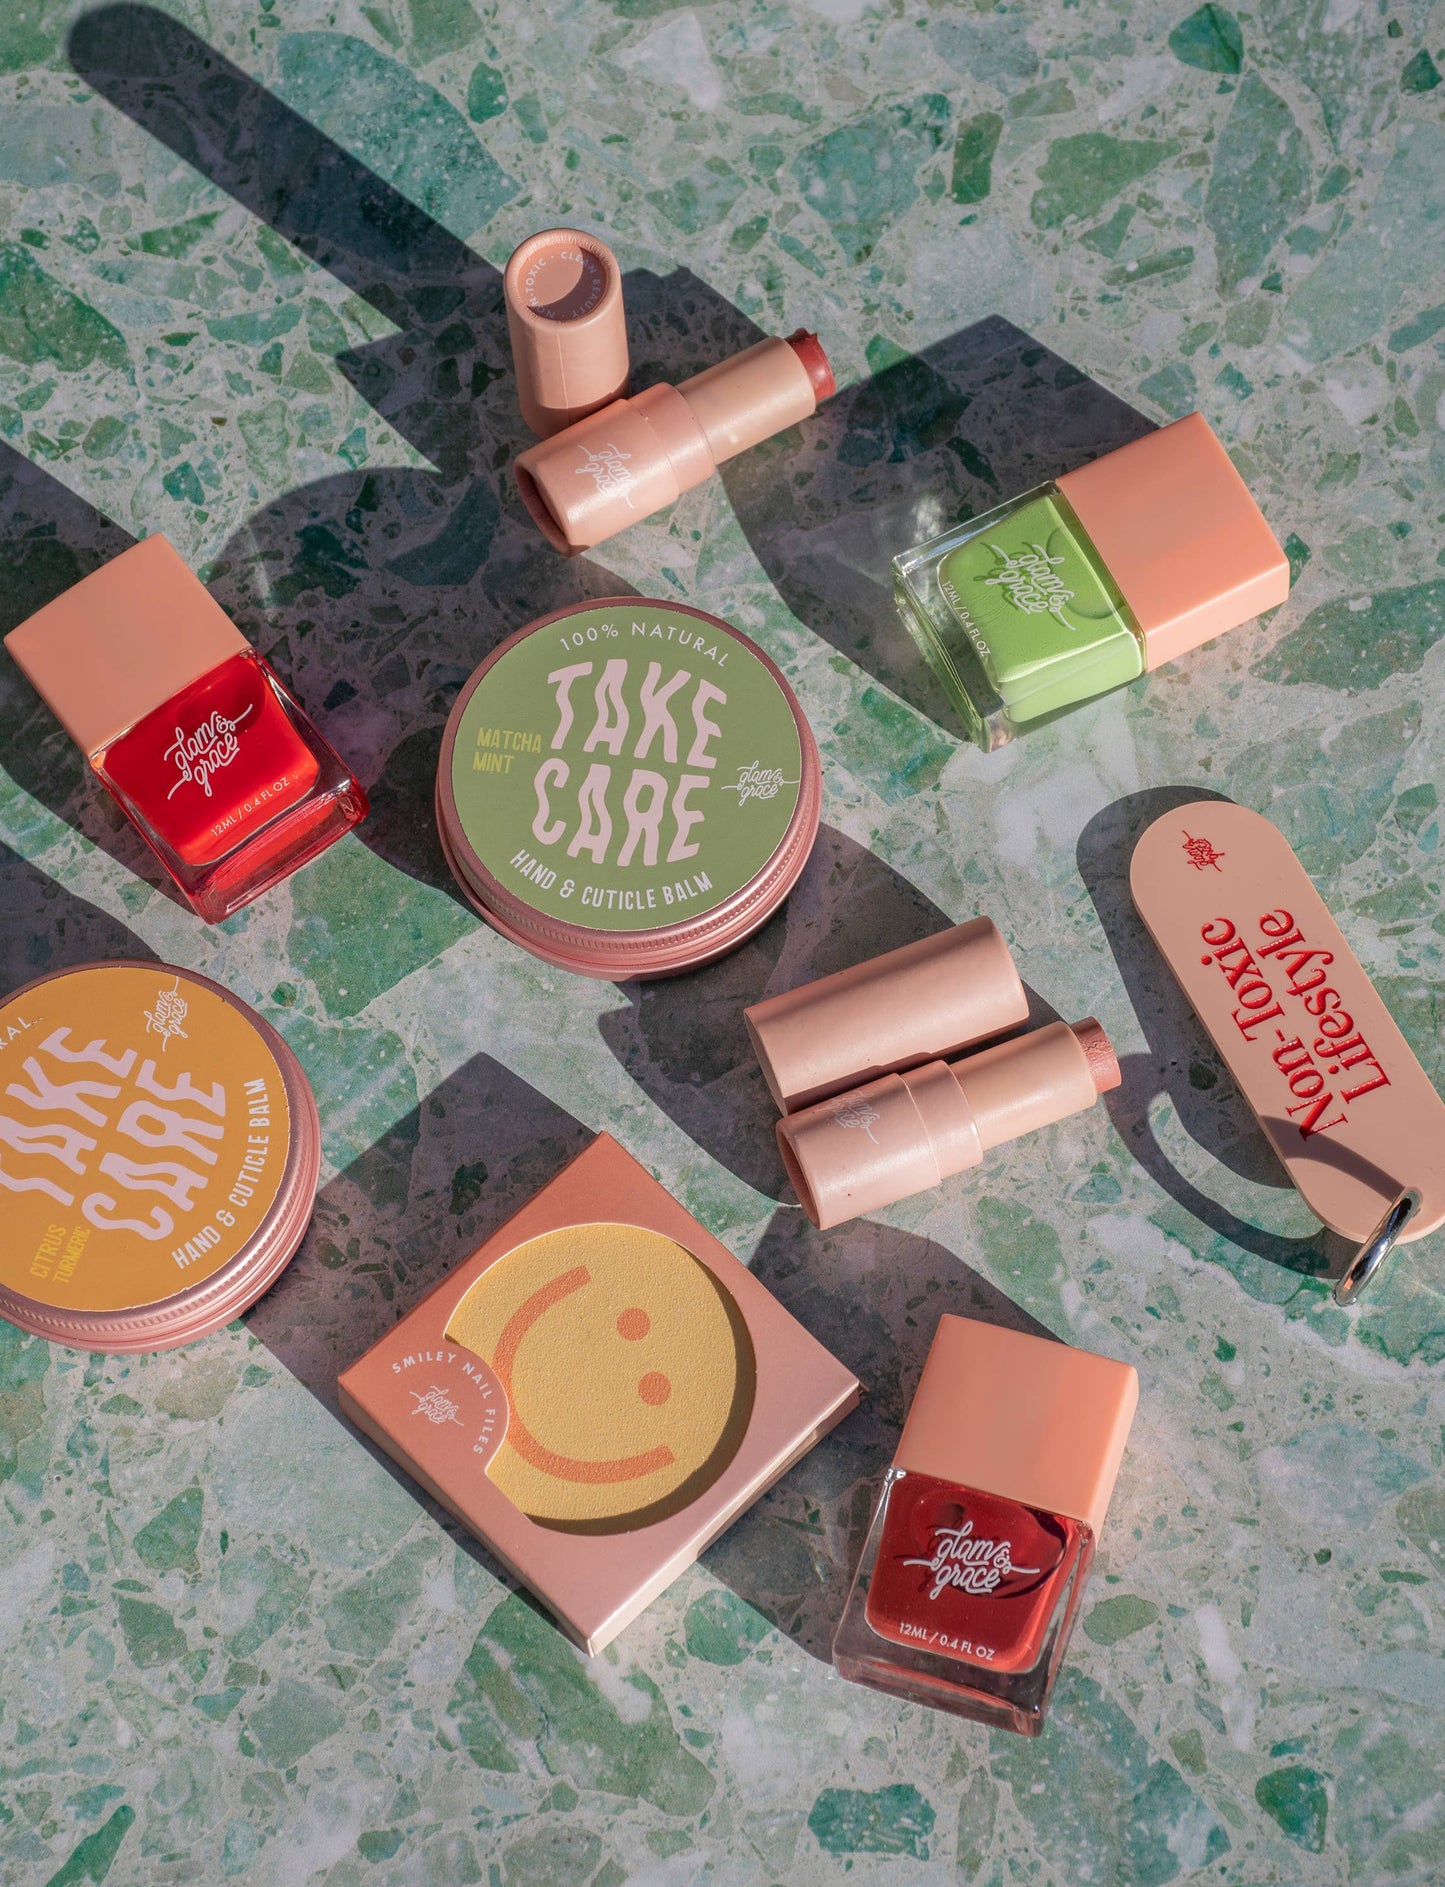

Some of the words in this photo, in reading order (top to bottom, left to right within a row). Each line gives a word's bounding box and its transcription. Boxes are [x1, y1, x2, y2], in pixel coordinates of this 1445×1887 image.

[560, 251, 598, 274] CLEAN
[571, 278, 601, 318] BEAUTY
[985, 569, 1049, 615] grace
[942, 580, 961, 606] 12ML
[960, 611, 976, 629] 0.4
[969, 628, 981, 641] FL
[976, 640, 991, 657] OZ
[559, 623, 619, 652] 100%
[631, 621, 730, 667] NATURAL
[547, 658, 727, 769] TAKE
[472, 751, 516, 775] MINT
[476, 727, 543, 753] MATCHA
[193, 732, 241, 798] grace
[210, 815, 237, 837] 12ML
[243, 797, 261, 812] 0.4
[260, 789, 273, 801] FL
[272, 776, 290, 792] OZ
[532, 758, 711, 868] CARE
[738, 783, 779, 807] grace
[510, 848, 557, 891] HAND
[559, 878, 575, 899] &
[581, 885, 656, 911] CUTICLE
[662, 871, 714, 906] BALM
[168, 998, 189, 1039] grace
[1200, 917, 1349, 1142] Non-Toxic
[1256, 908, 1392, 1105] Lifestyle
[0, 1026, 138, 1207] TAKE
[243, 1077, 270, 1127] BALM
[81, 1059, 227, 1241] CARE
[228, 1134, 270, 1208] CUTICLE
[215, 1208, 236, 1228] &
[29, 1224, 67, 1279] CITRUS
[52, 1225, 91, 1283] TURMERIC
[171, 1224, 222, 1270] HAND
[392, 1351, 457, 1374] SMILEY
[462, 1362, 493, 1400] NAIL
[411, 1402, 448, 1425] grace
[473, 1408, 496, 1454] FILES
[929, 1563, 1002, 1600] grace
[899, 1622, 928, 1642] 12ML
[939, 1635, 958, 1650] 0.4
[960, 1642, 972, 1655] FL
[975, 1645, 995, 1662] OZ
